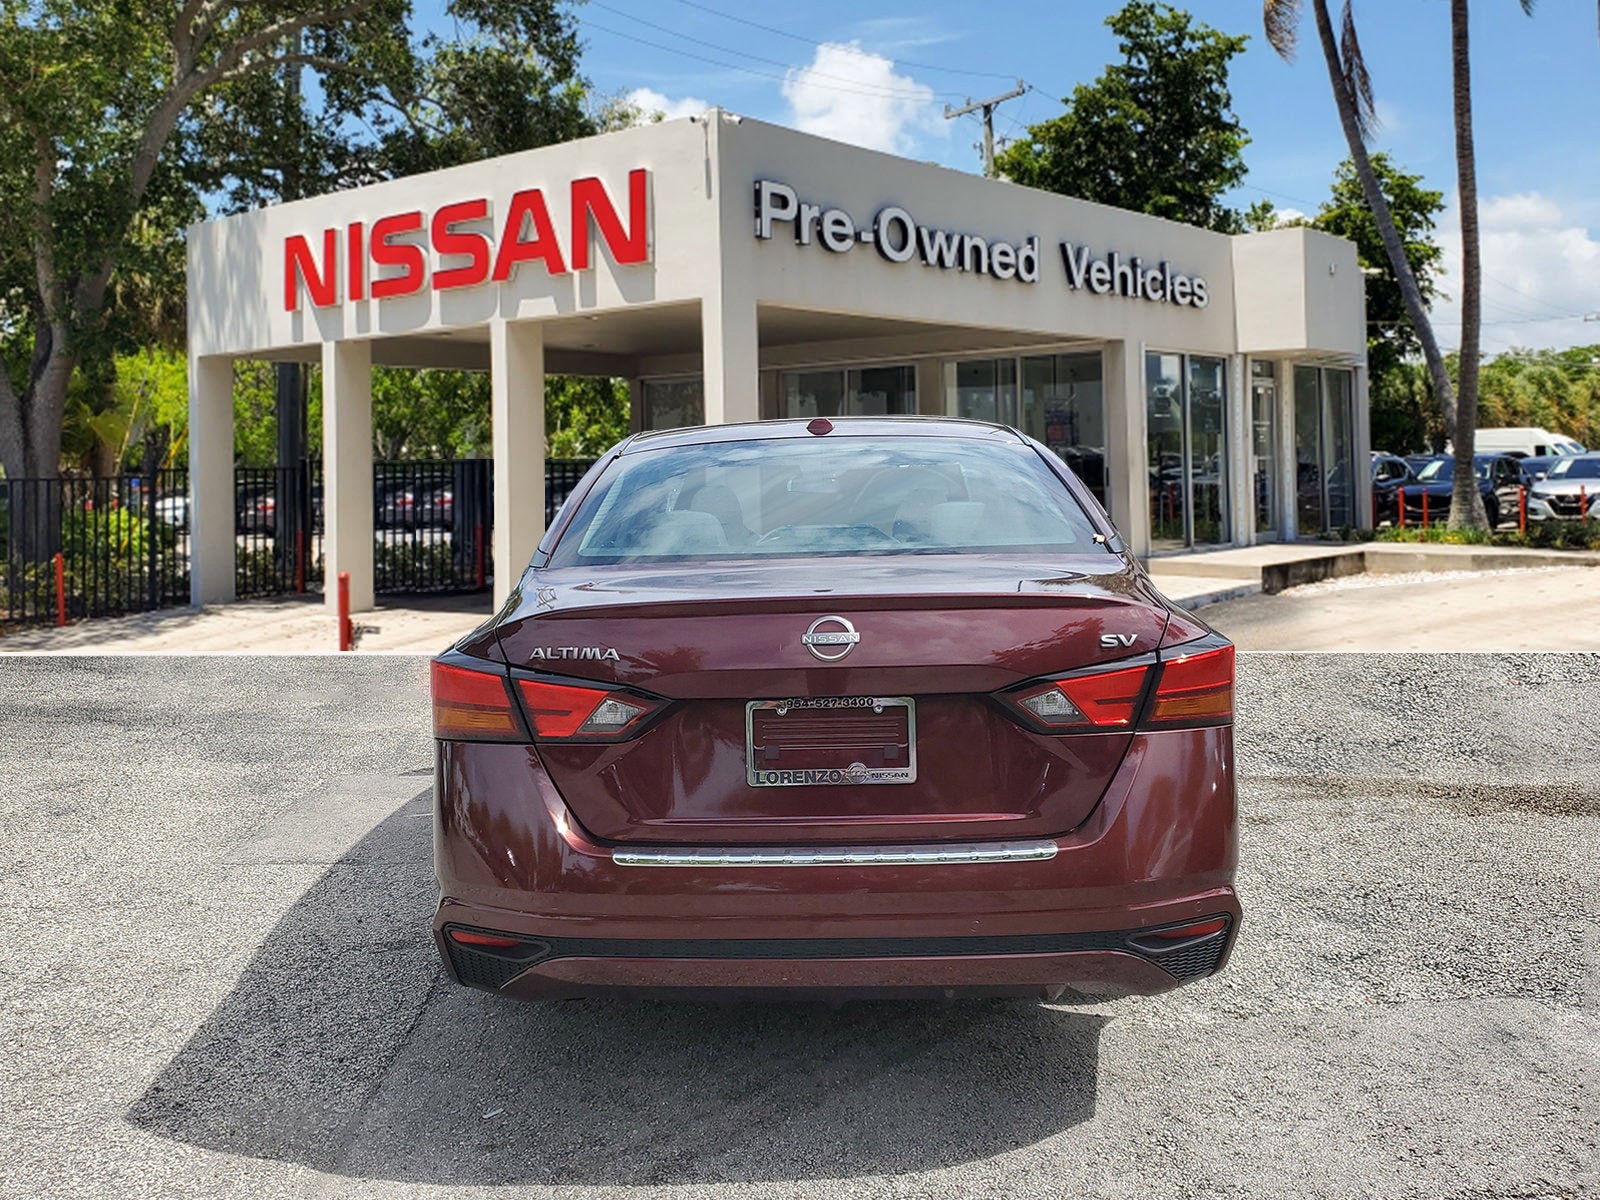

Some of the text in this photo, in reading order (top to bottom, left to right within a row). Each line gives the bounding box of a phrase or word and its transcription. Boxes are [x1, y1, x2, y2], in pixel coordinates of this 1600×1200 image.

[284, 168, 648, 312] NISSAN
[754, 179, 1209, 309] Pre-Owned Vehicles
[803, 634, 858, 643] NISSAN
[1100, 633, 1138, 648] SV
[528, 646, 621, 662] ALTIMA
[755, 770, 843, 785] LORENZO
